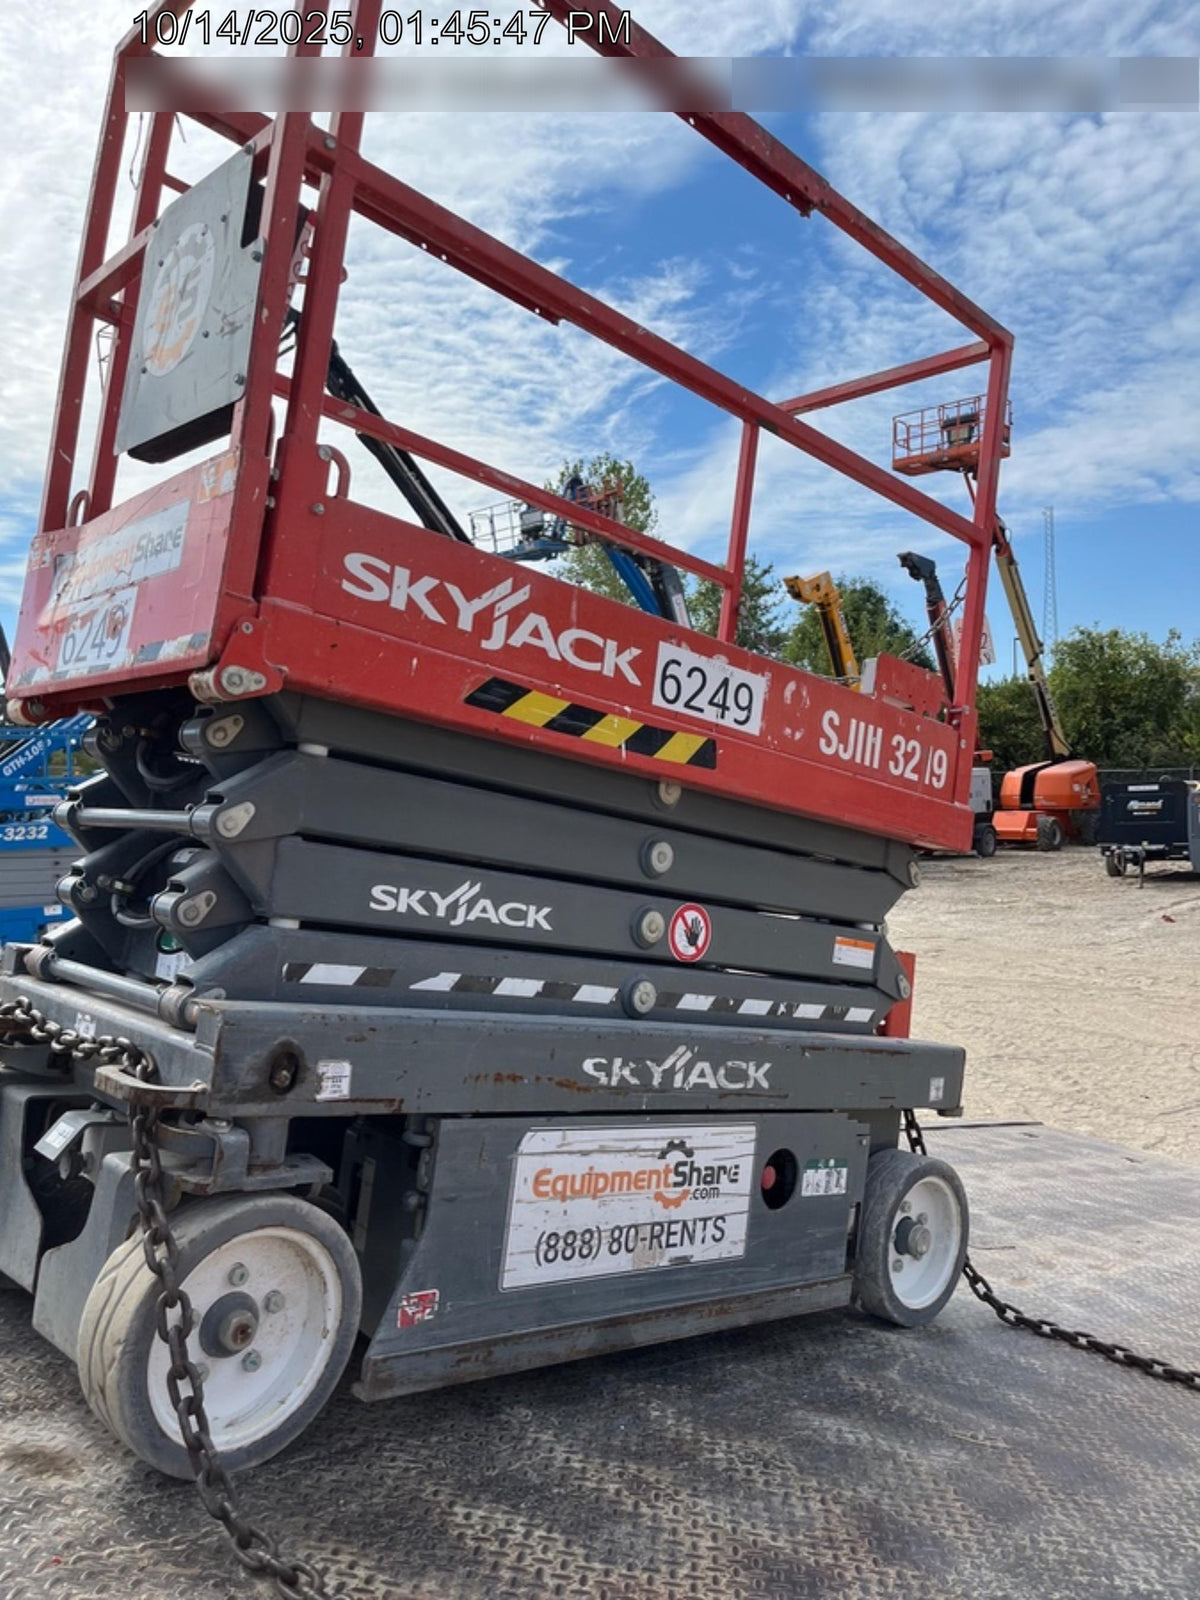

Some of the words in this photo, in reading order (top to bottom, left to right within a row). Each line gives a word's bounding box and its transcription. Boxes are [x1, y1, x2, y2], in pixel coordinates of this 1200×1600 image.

[341, 552, 643, 687] SKYJACK
[659, 657, 754, 728] 6249
[368, 879, 553, 932] SKYJACK
[581, 1044, 773, 1091] SKYJACK
[532, 1160, 741, 1203] EquipmentShare
[688, 1185, 721, 1201] .com
[534, 1225, 602, 1267] (888)
[606, 1214, 727, 1256] 80-RENTS
